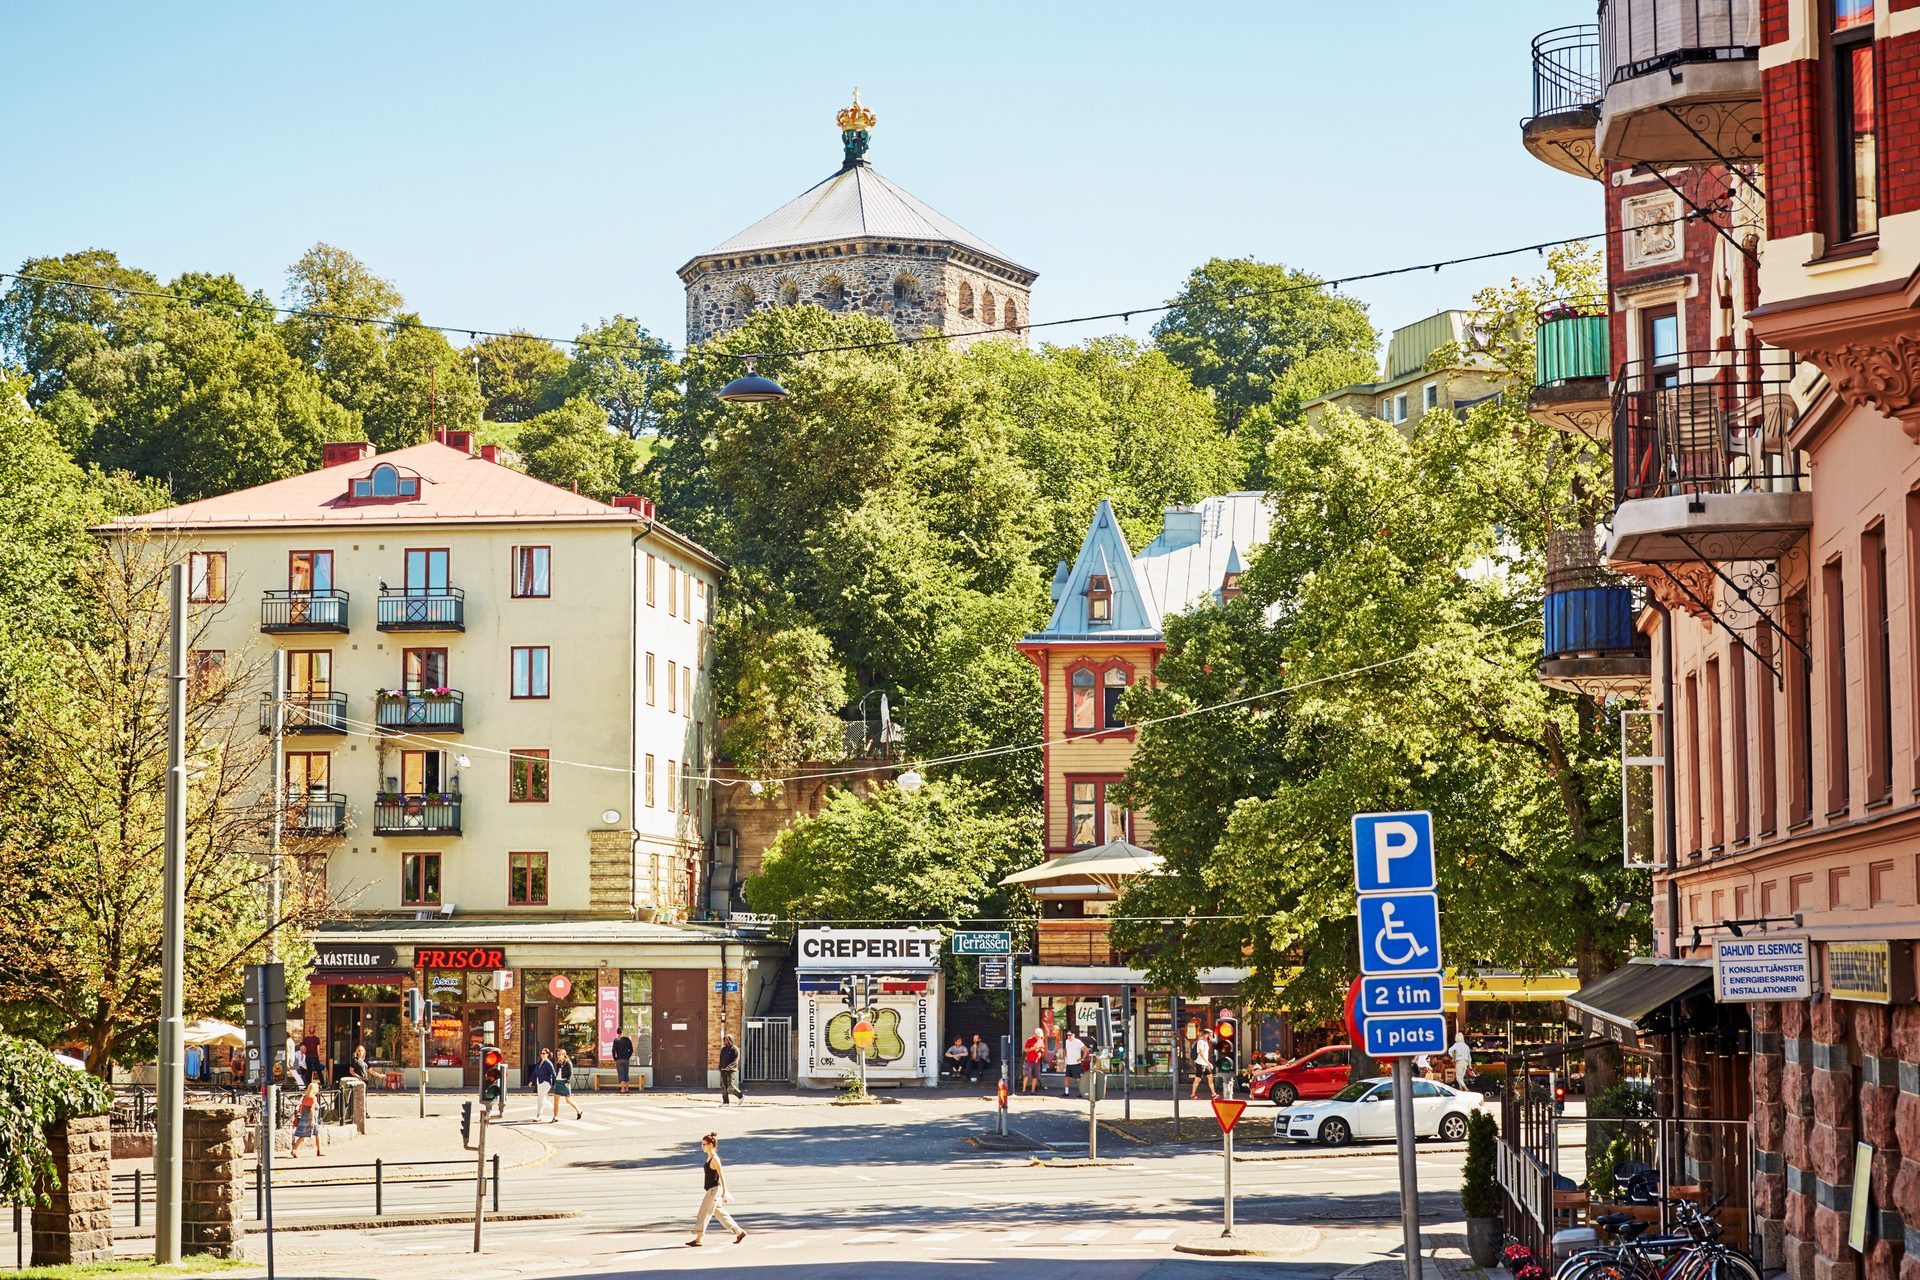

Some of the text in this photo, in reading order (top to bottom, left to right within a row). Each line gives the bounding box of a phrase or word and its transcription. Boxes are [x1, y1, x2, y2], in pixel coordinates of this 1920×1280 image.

[1373, 821, 1418, 884] P
[803, 938, 935, 958] CREPERIET
[954, 934, 1009, 953] Terrassen
[1720, 943, 1803, 957] DAHLVID ELSERVICE
[415, 948, 503, 968] FRISÖR
[1728, 964, 1804, 974] KONSULTTJÄNSTER
[1729, 975, 1805, 985] ENERGIBESPARING
[1375, 985, 1430, 1005] 2 tim
[1730, 985, 1797, 995] INSTALLATIONER
[918, 999, 927, 1073] CREPERIET
[1376, 1027, 1435, 1046] 1 plats
